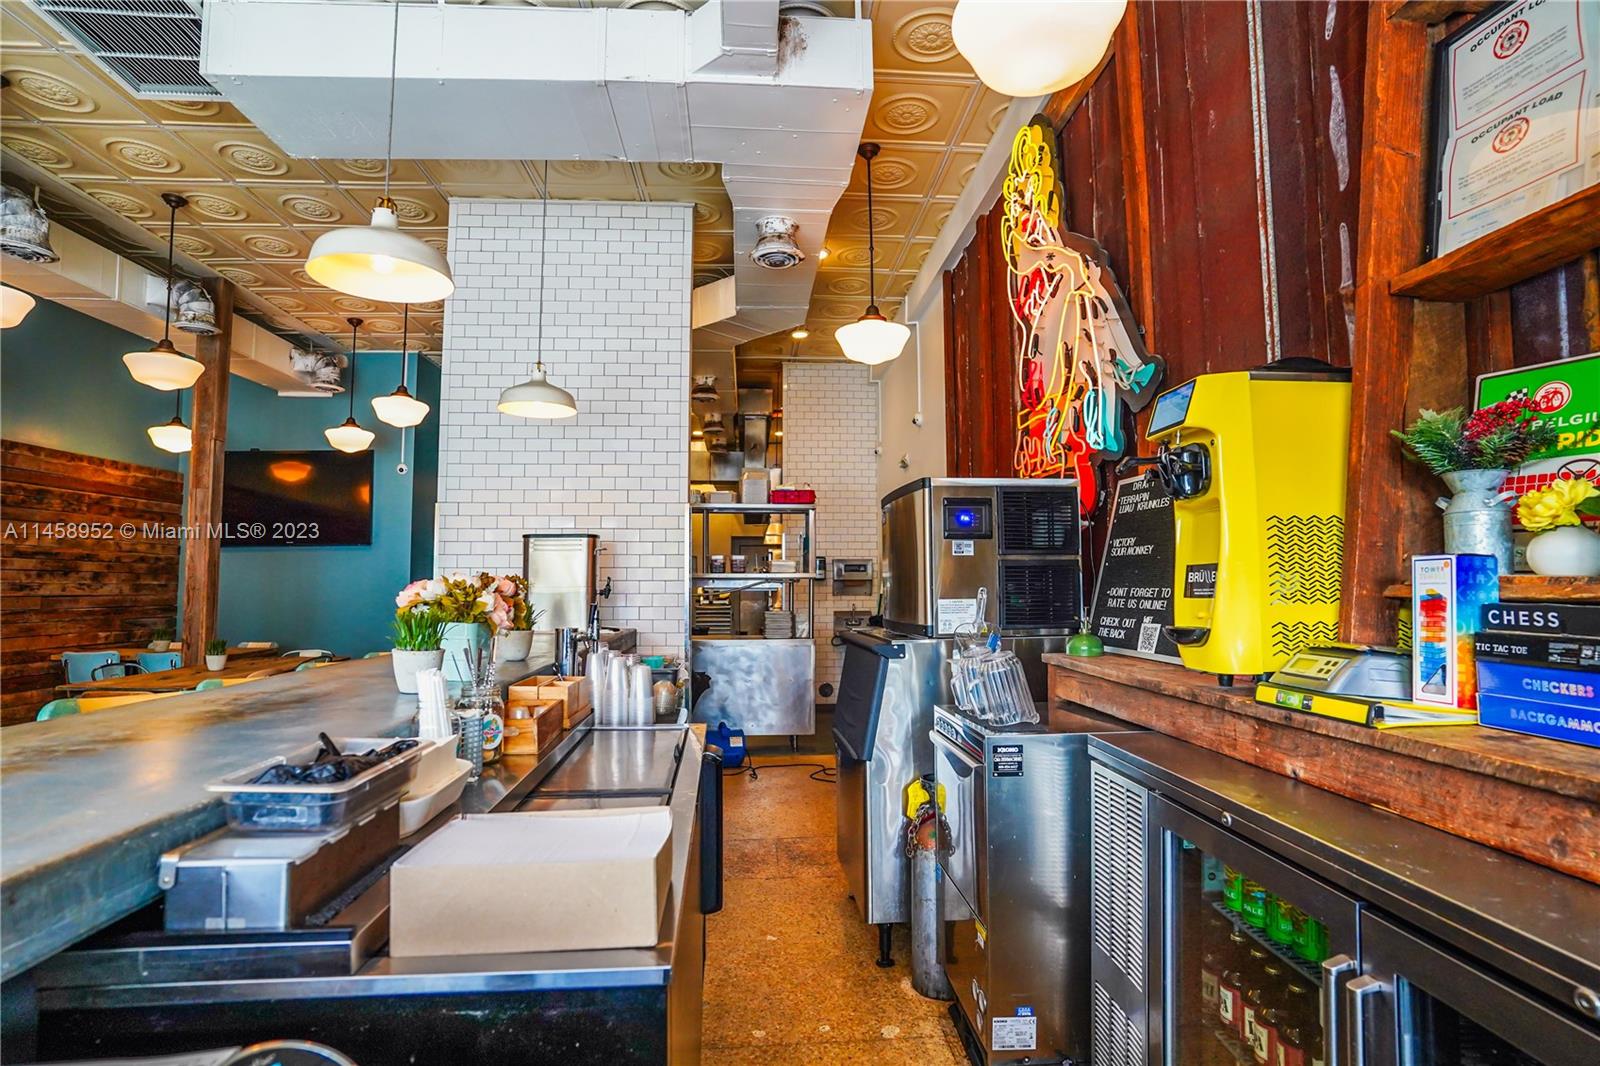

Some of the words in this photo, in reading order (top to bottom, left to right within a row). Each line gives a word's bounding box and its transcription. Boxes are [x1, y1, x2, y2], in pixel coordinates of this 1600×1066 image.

[1470, 7, 1525, 53] OCCUPANT
[1528, 0, 1546, 10] LO
[1471, 105, 1530, 144] OCCUPANT
[1531, 91, 1563, 109] LOAD
[1132, 480, 1155, 491] DRA
[1120, 492, 1150, 505] TERRAPIN
[1137, 497, 1170, 511] KRUNKLES
[1113, 537, 1136, 547] VICTORY
[1111, 547, 1127, 557] SOUR
[1127, 545, 1154, 556] MONKEY
[1129, 588, 1159, 598] FORGET
[1161, 588, 1172, 598] TO
[1107, 598, 1125, 608] RATE
[1127, 599, 1137, 609] US
[1140, 599, 1167, 610] ONLINE!
[1100, 616, 1120, 627] CHECK
[1122, 618, 1137, 628] OUT
[1488, 609, 1560, 628] CHESS
[1098, 627, 1110, 637] THE
[1110, 628, 1127, 639] BACK
[1475, 642, 1491, 651] TIC
[1492, 643, 1509, 653] TAC
[1510, 645, 1528, 654] TOE
[1522, 678, 1594, 698] CHECKERS
